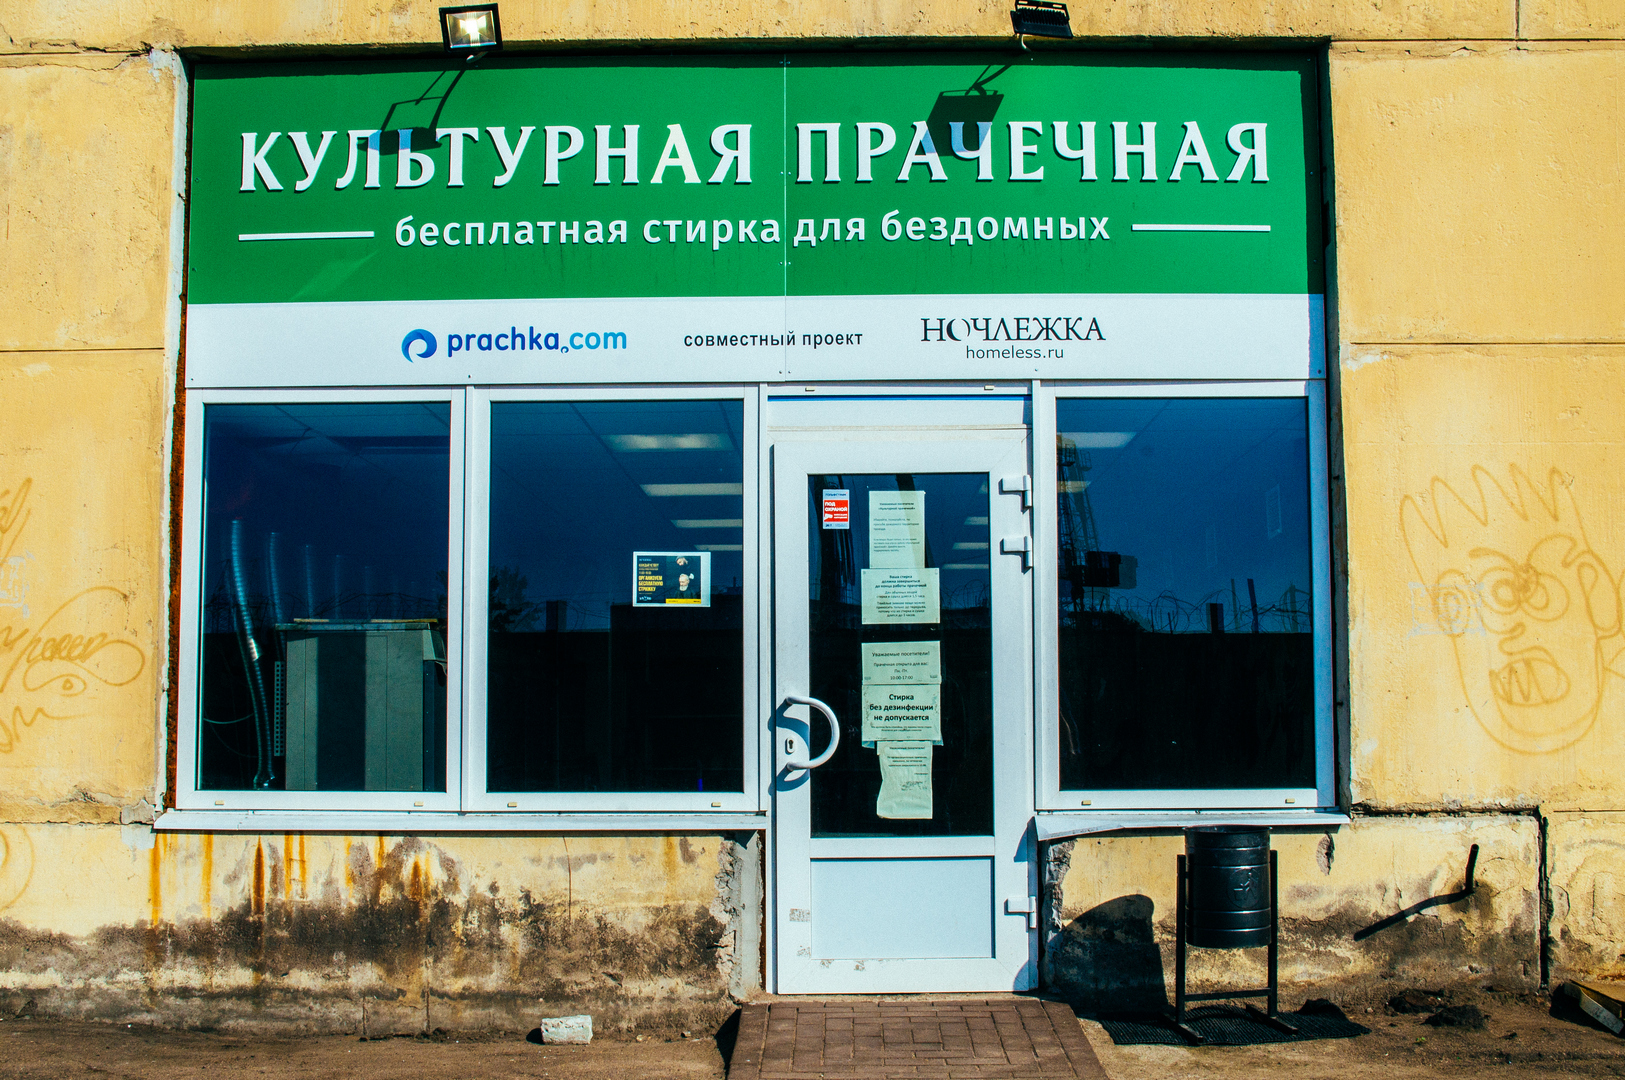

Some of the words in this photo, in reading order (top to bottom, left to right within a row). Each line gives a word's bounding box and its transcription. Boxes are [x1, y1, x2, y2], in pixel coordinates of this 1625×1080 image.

[240, 124, 752, 191] КУЛЬТУРНАЯ
[796, 120, 1269, 182] ПРАЧЕЧНАЯ
[395, 215, 628, 247] бесплатная
[642, 218, 780, 250] стирка
[793, 217, 866, 246] для
[881, 210, 1111, 245] бездомных
[448, 326, 627, 358] prachka.com
[683, 330, 796, 347] совместный
[802, 332, 864, 350] проект
[920, 316, 1106, 342] НОЧЛЕЖКА
[966, 346, 1064, 360] homeless.ru
